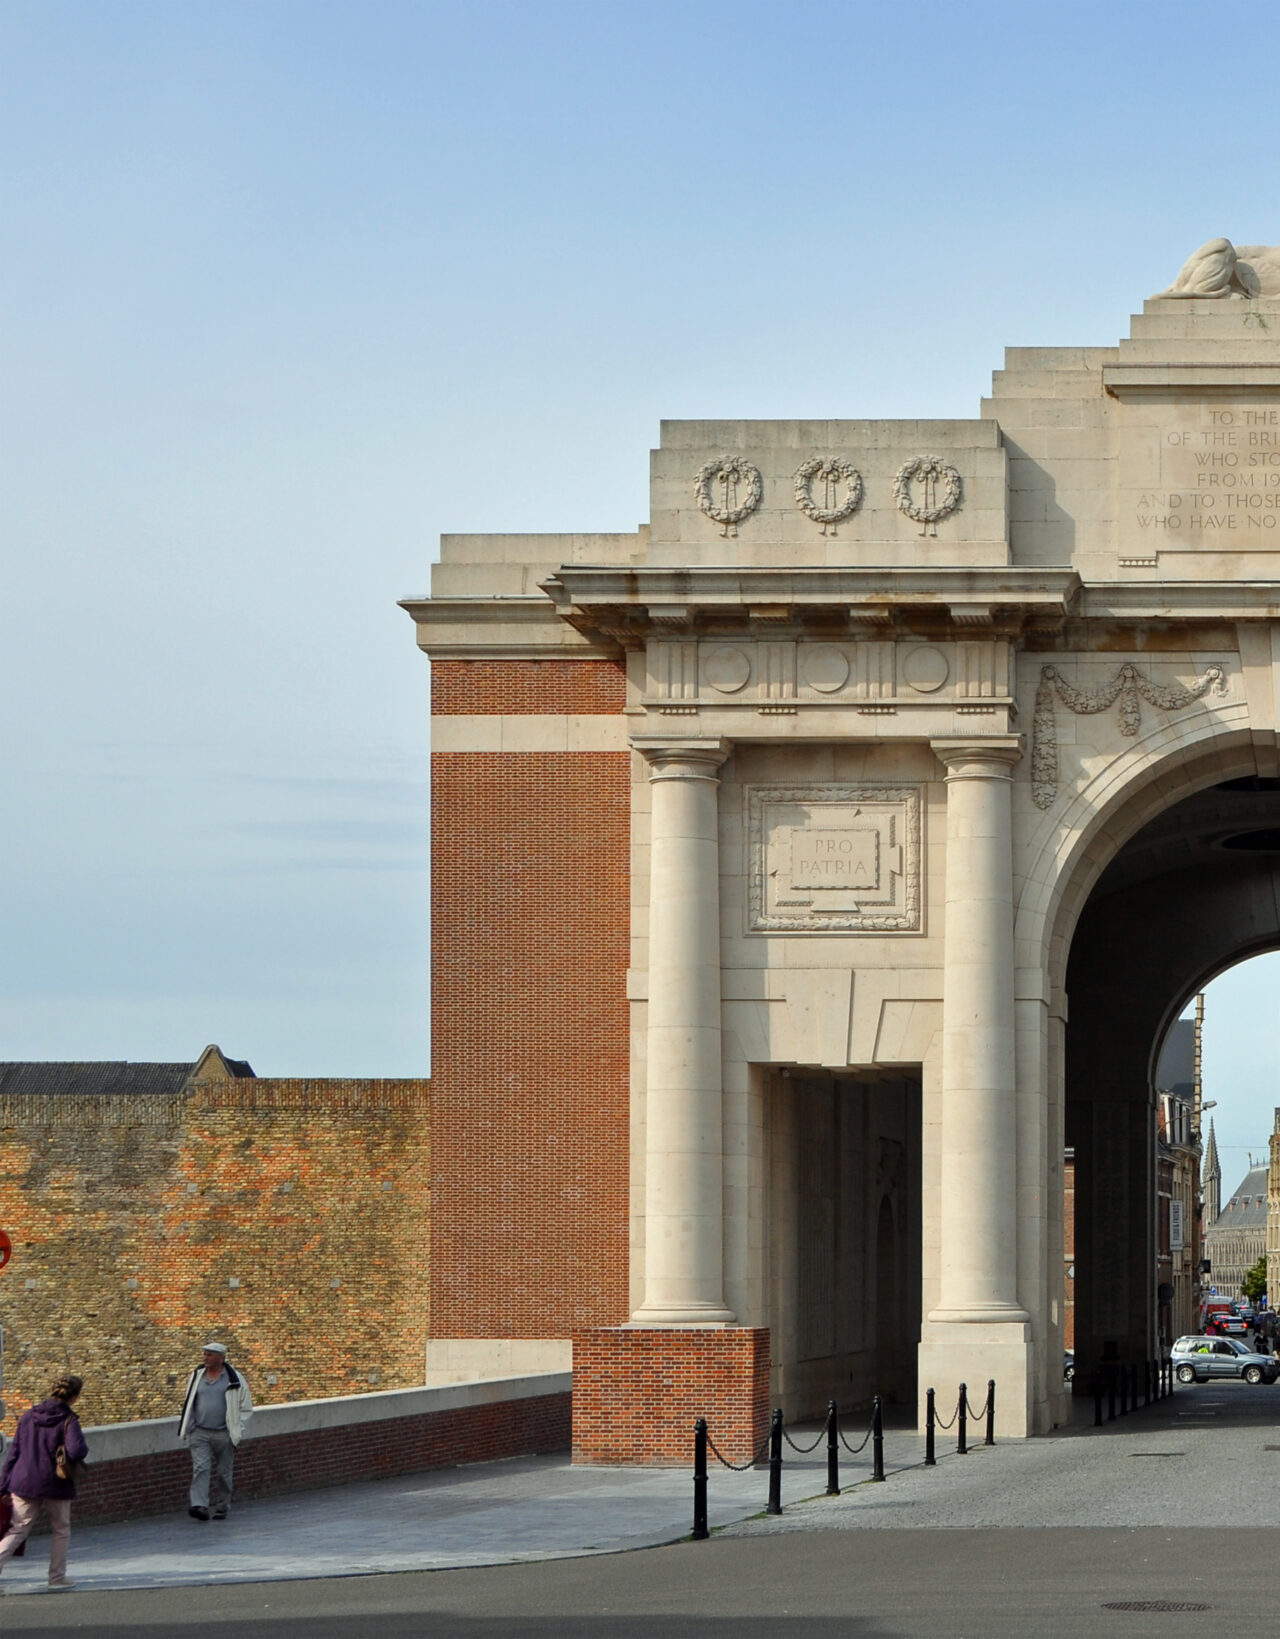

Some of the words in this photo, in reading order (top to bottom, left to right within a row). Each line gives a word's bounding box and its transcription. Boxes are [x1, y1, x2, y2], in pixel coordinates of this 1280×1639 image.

[1208, 410, 1234, 426] TO
[1241, 410, 1279, 426] THE
[1167, 431, 1191, 447] OF
[1200, 431, 1238, 447] THE
[1193, 451, 1239, 468] WHO
[1197, 472, 1255, 488] FROM
[1189, 493, 1215, 509] TO
[1136, 514, 1182, 530] WHO
[1189, 514, 1238, 530] HAVE
[1247, 514, 1277, 530] NO
[815, 839, 853, 854] PRO
[800, 860, 867, 875] PATRIA
